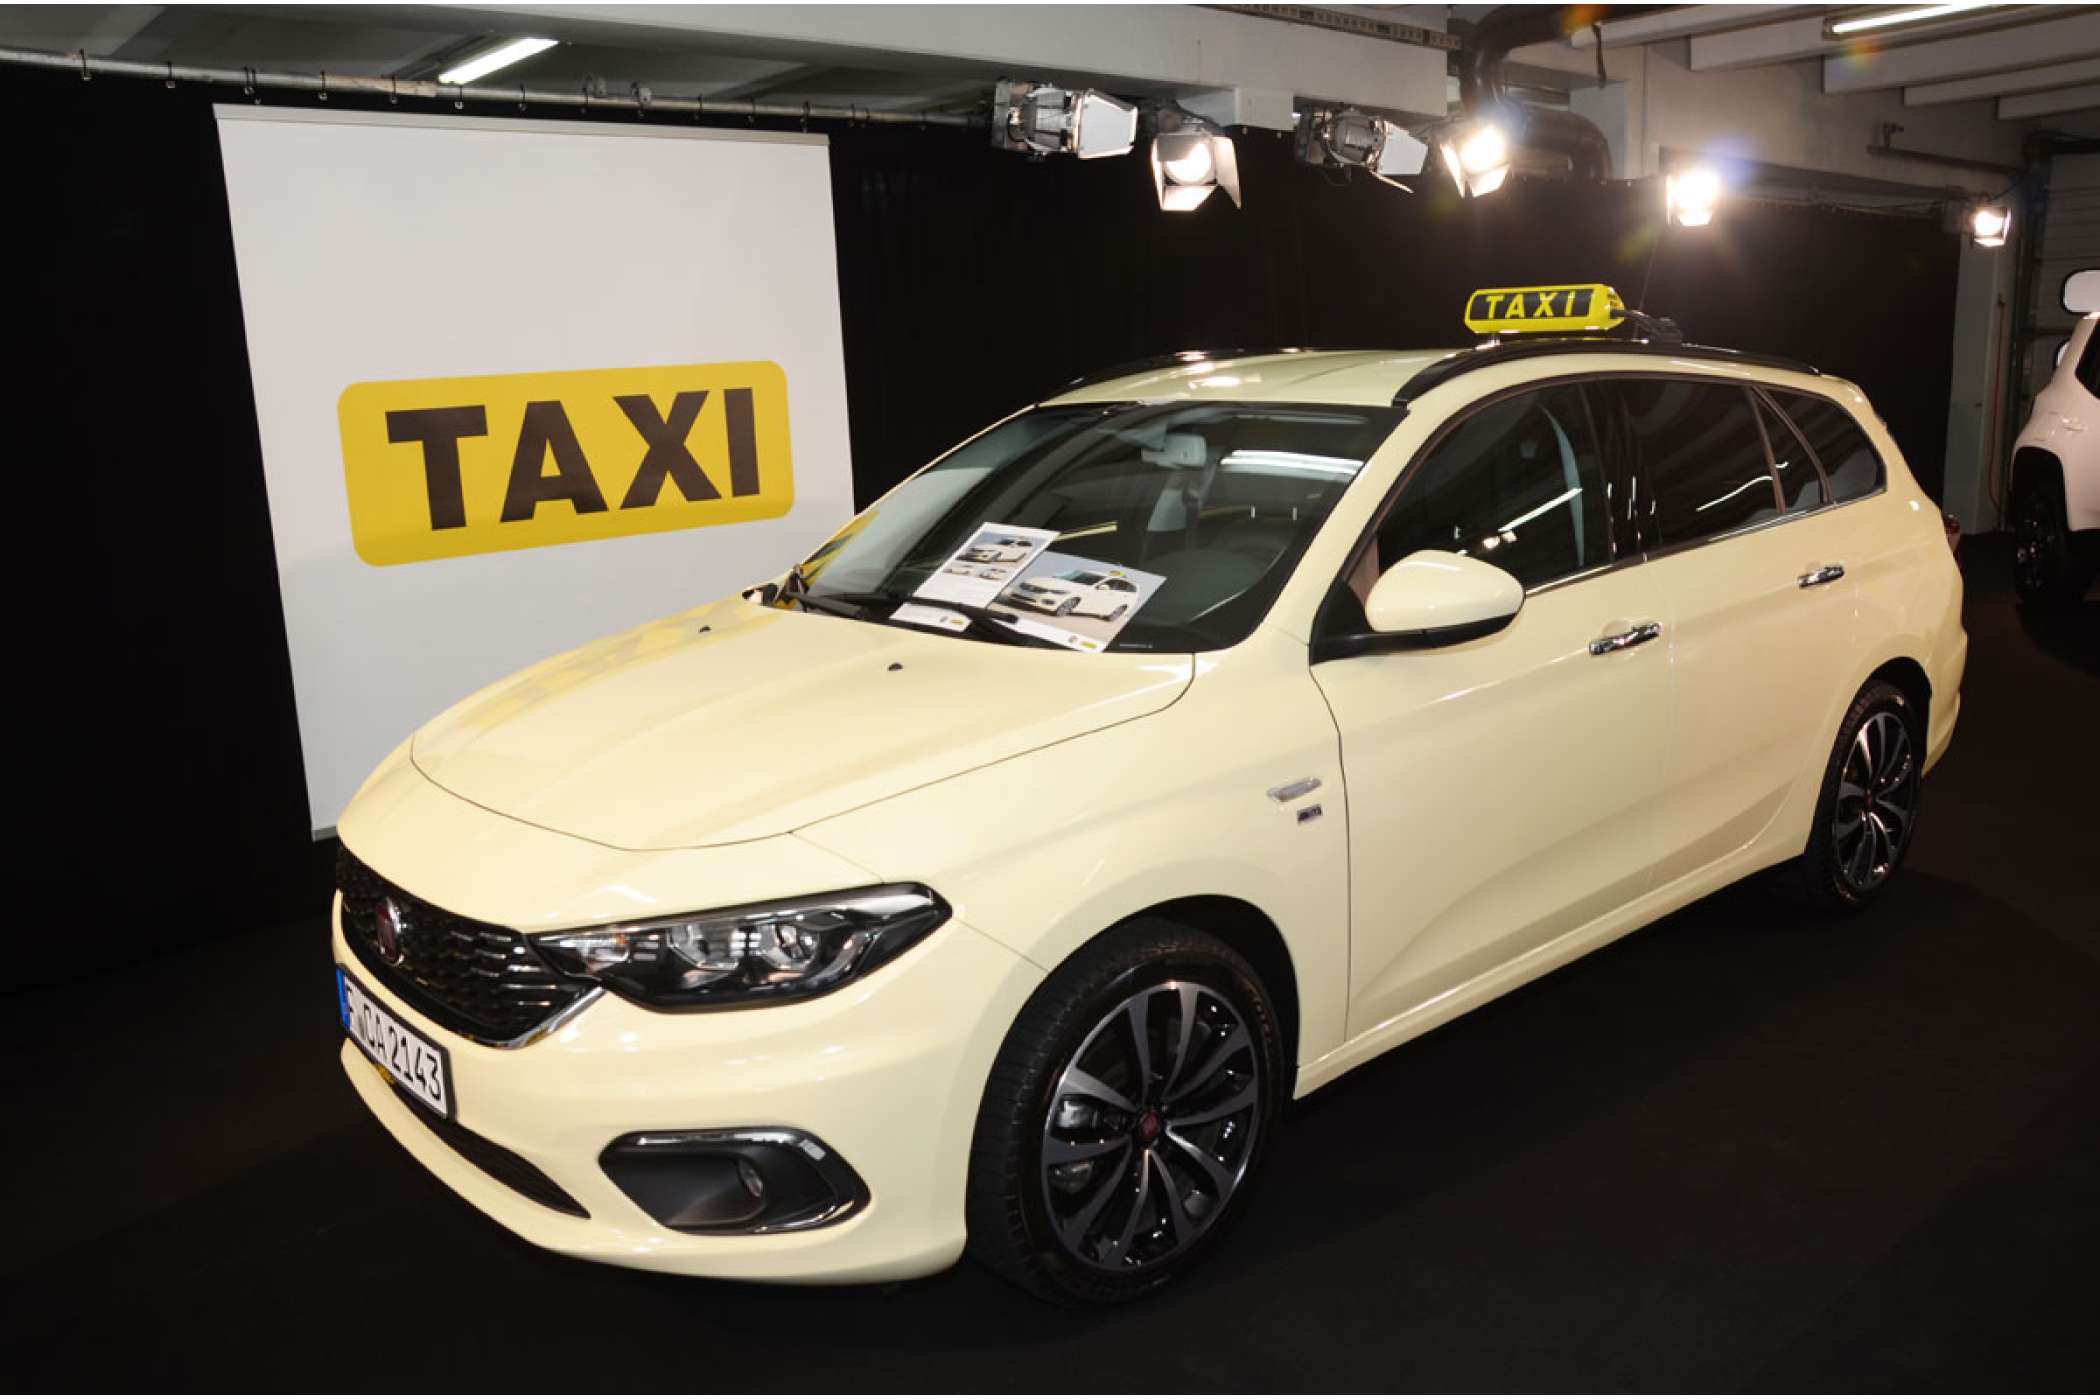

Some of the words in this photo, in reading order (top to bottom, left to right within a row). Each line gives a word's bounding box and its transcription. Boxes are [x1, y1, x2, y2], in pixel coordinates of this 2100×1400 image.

[1485, 290, 1576, 319] TAXI
[385, 387, 760, 531] TAXI
[388, 1025, 442, 1101] 2143
